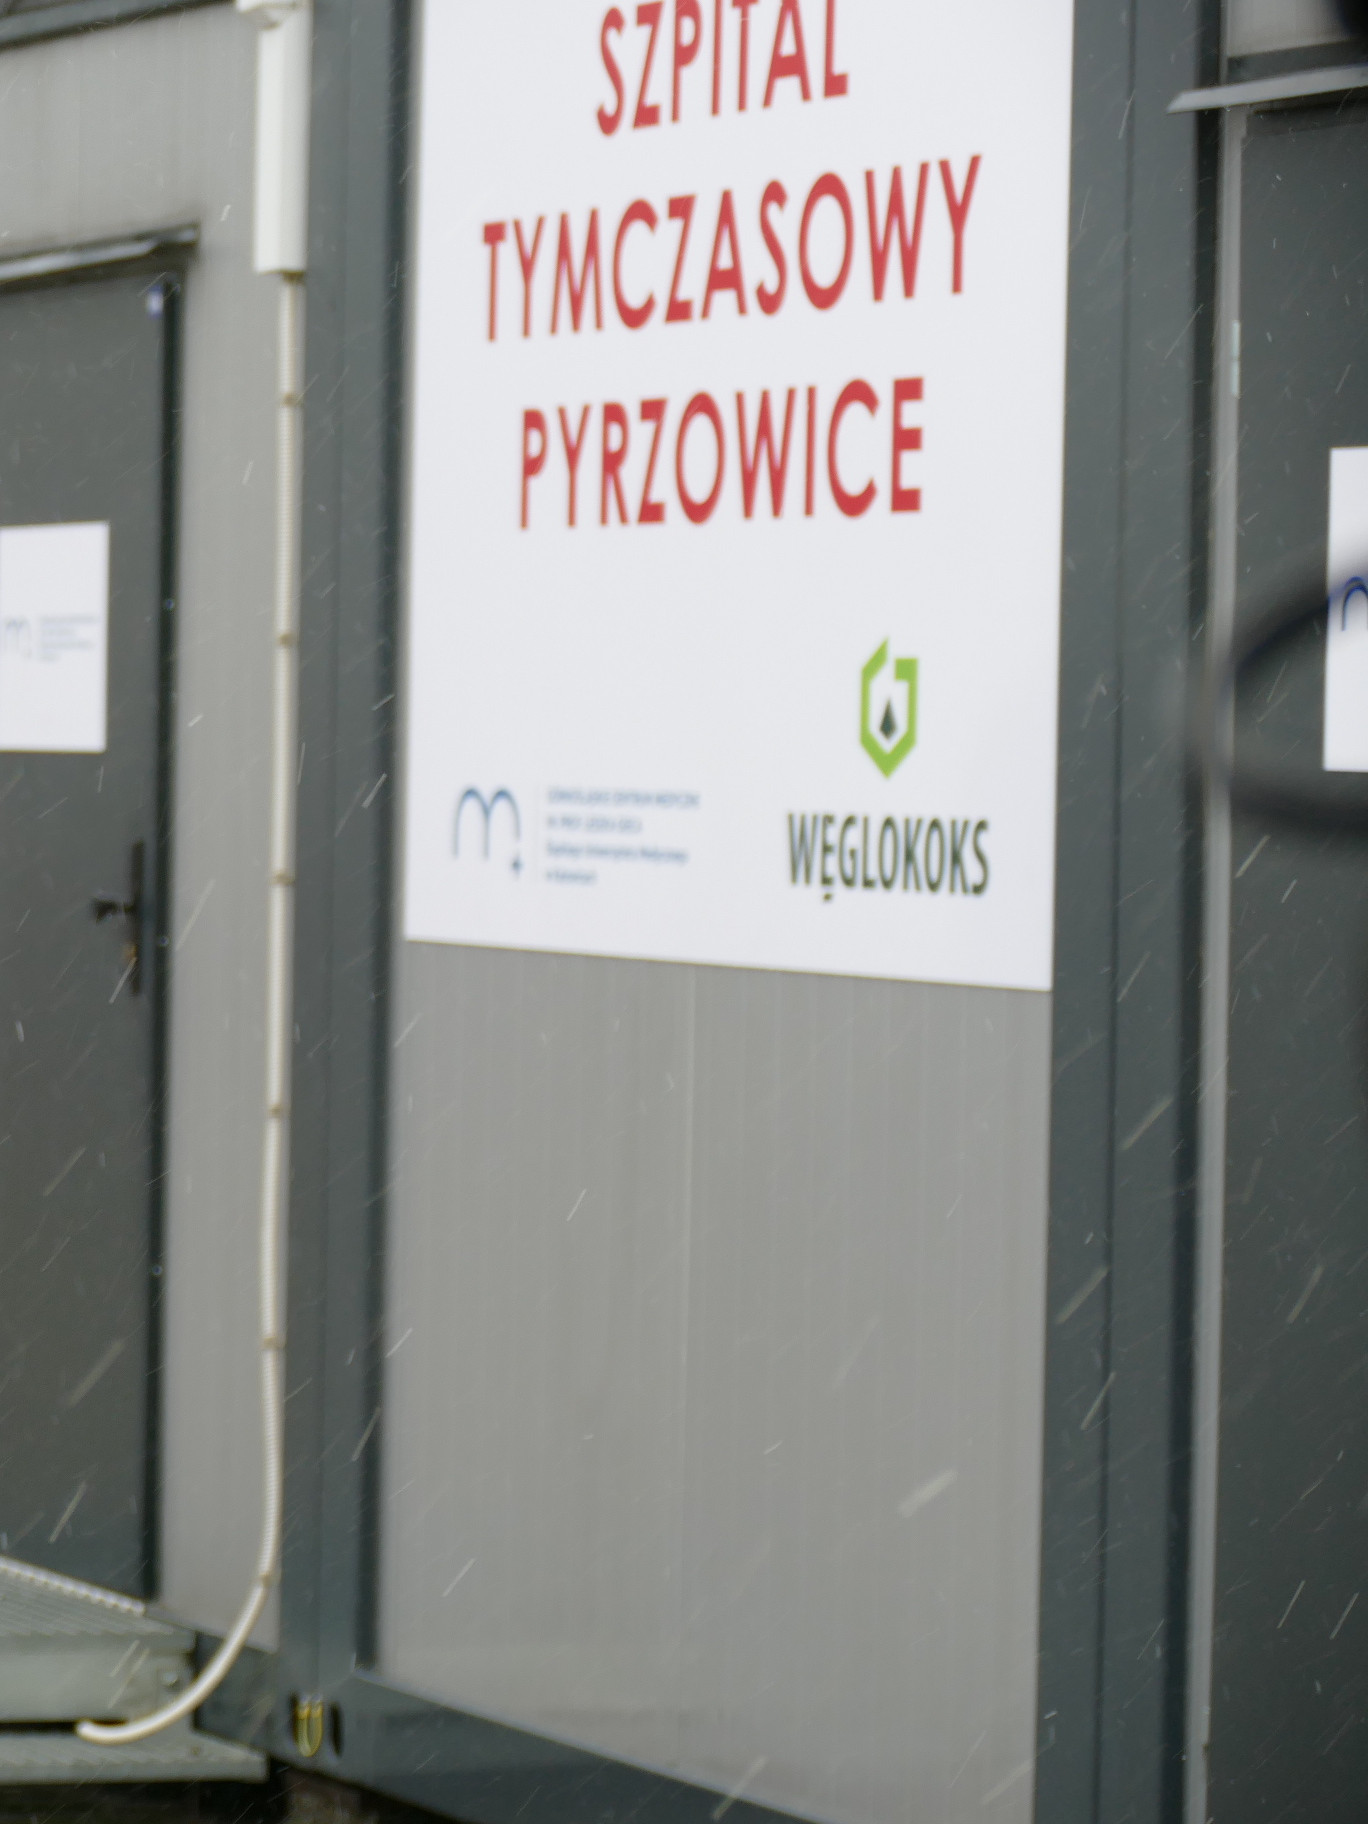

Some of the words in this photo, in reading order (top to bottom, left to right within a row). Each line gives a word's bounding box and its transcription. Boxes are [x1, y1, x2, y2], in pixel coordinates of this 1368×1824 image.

[596, 0, 849, 137] SZPITAL
[482, 154, 982, 342] TYMCZASOWY
[520, 376, 924, 530] PYRZOWICE
[786, 813, 990, 903] WĘGLOKOKS
